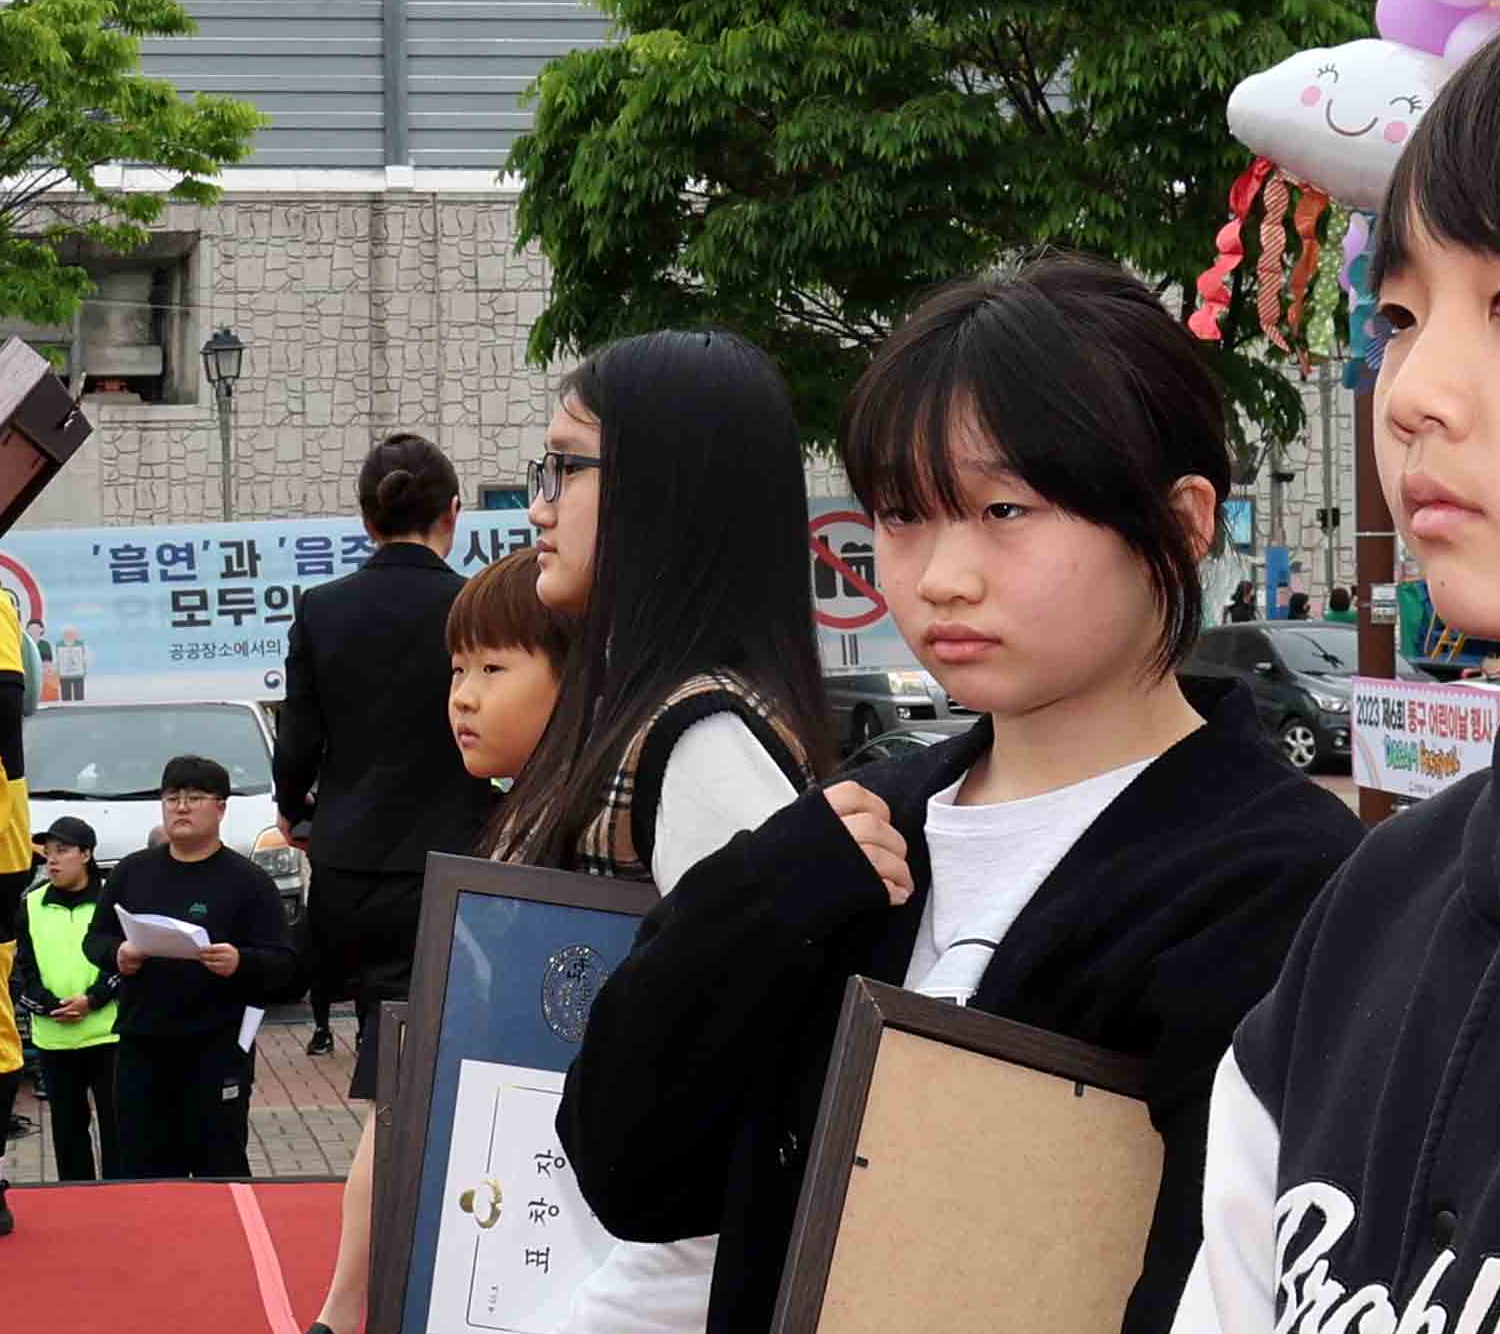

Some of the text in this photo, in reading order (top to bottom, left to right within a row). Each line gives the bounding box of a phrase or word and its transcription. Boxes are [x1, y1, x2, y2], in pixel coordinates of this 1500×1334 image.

[170, 584, 303, 628] 모두의
[169, 638, 282, 661] 공공장소에서의
[1356, 694, 1493, 744] 2023 제6회 동구 어린이날 행사
